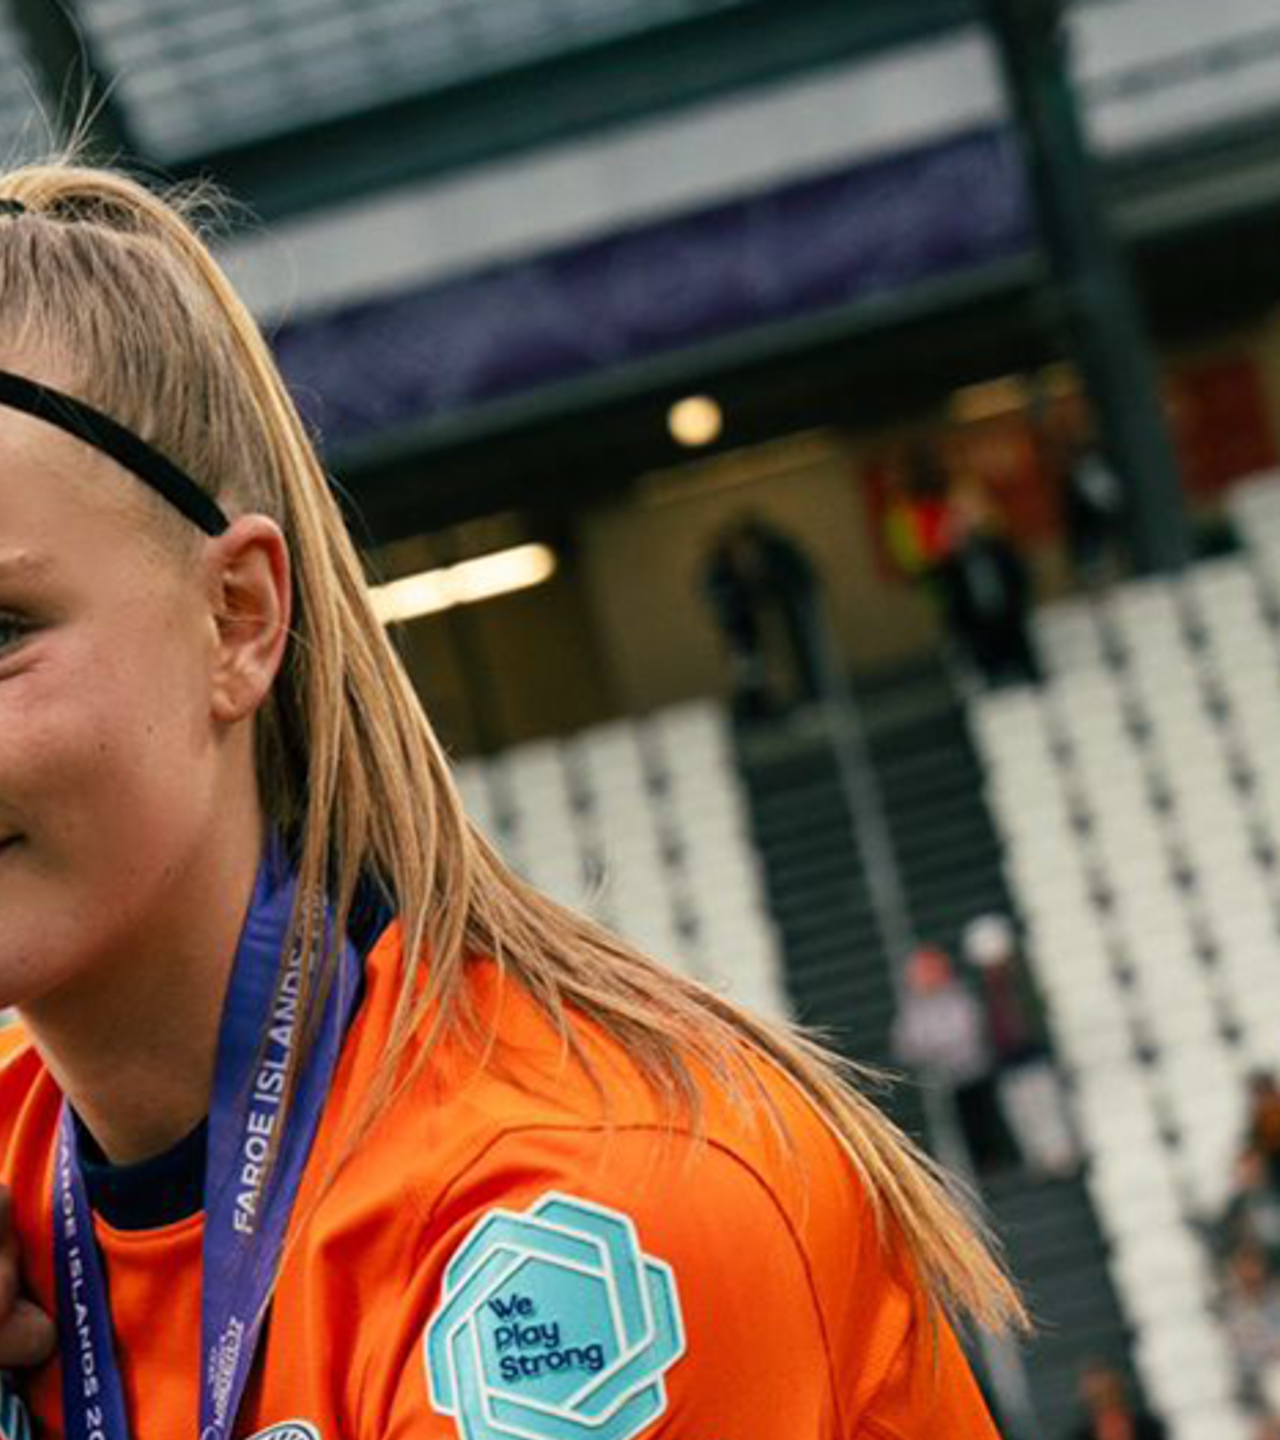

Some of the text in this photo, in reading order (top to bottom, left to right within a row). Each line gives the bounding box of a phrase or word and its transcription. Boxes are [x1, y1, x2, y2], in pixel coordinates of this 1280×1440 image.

[233, 1112, 275, 1235] FAROE
[67, 1245, 100, 1399] ISLANDS
[488, 1294, 533, 1319] We
[494, 1321, 559, 1352] Play
[499, 1344, 604, 1382] Strong
